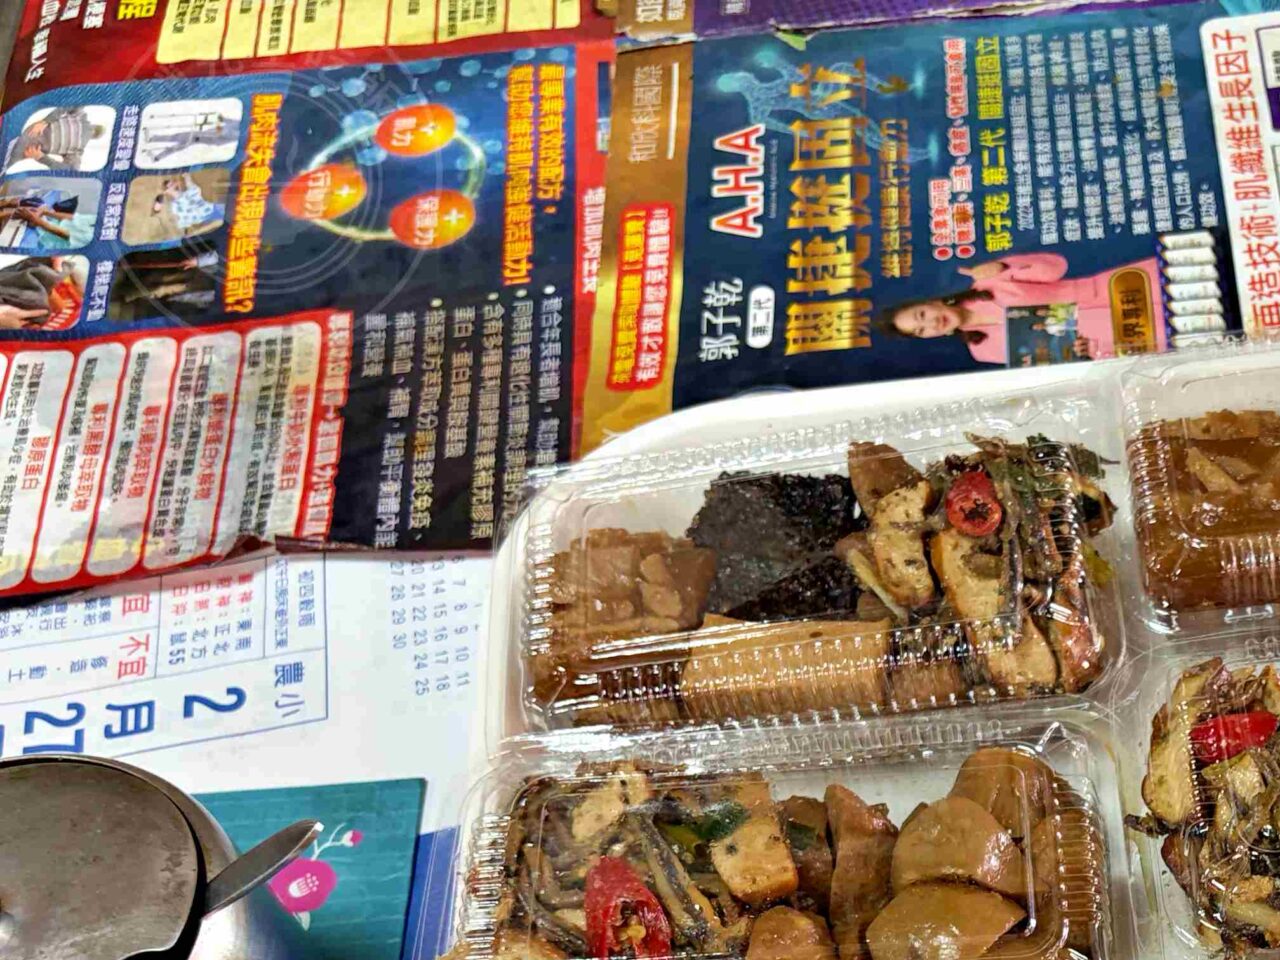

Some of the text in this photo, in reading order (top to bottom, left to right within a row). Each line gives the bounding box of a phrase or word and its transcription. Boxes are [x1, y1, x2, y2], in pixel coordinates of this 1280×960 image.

[113, 105, 140, 171] 走路速度變慢
[391, 117, 417, 147] 肌力
[979, 128, 1008, 186] 第二代
[502, 64, 535, 286] 幫助您維持肌肉強健活動力!
[710, 123, 766, 239] A.H.A
[223, 94, 283, 313] 肌肉流失會出現哪些警訊?
[302, 170, 331, 219] 行動力
[877, 119, 912, 279] 維持健康行動力
[785, 57, 873, 356] 關捷挺固立
[413, 196, 440, 246] 保護力
[983, 191, 1013, 252] 郭子乾
[698, 277, 744, 362] 郭子乾
[751, 297, 773, 337] 第二代
[21, 436, 51, 490] 膠原蛋白
[390, 583, 405, 601] 28
[411, 582, 425, 600] 21
[432, 578, 446, 596] 14
[455, 577, 466, 588] 7
[122, 593, 151, 616] 宜
[433, 602, 447, 620] 15
[456, 602, 467, 612] 8
[391, 608, 407, 627] 29
[411, 606, 427, 624] 22
[411, 629, 428, 648] 23
[433, 625, 448, 644] 16
[456, 625, 468, 636] 9
[392, 632, 407, 651] 30
[117, 634, 151, 680] 不宜
[412, 653, 429, 672] 24
[434, 649, 449, 667] 17
[455, 645, 469, 664] 10
[414, 678, 430, 697] 25
[435, 674, 450, 693] 18
[456, 671, 470, 689] 11
